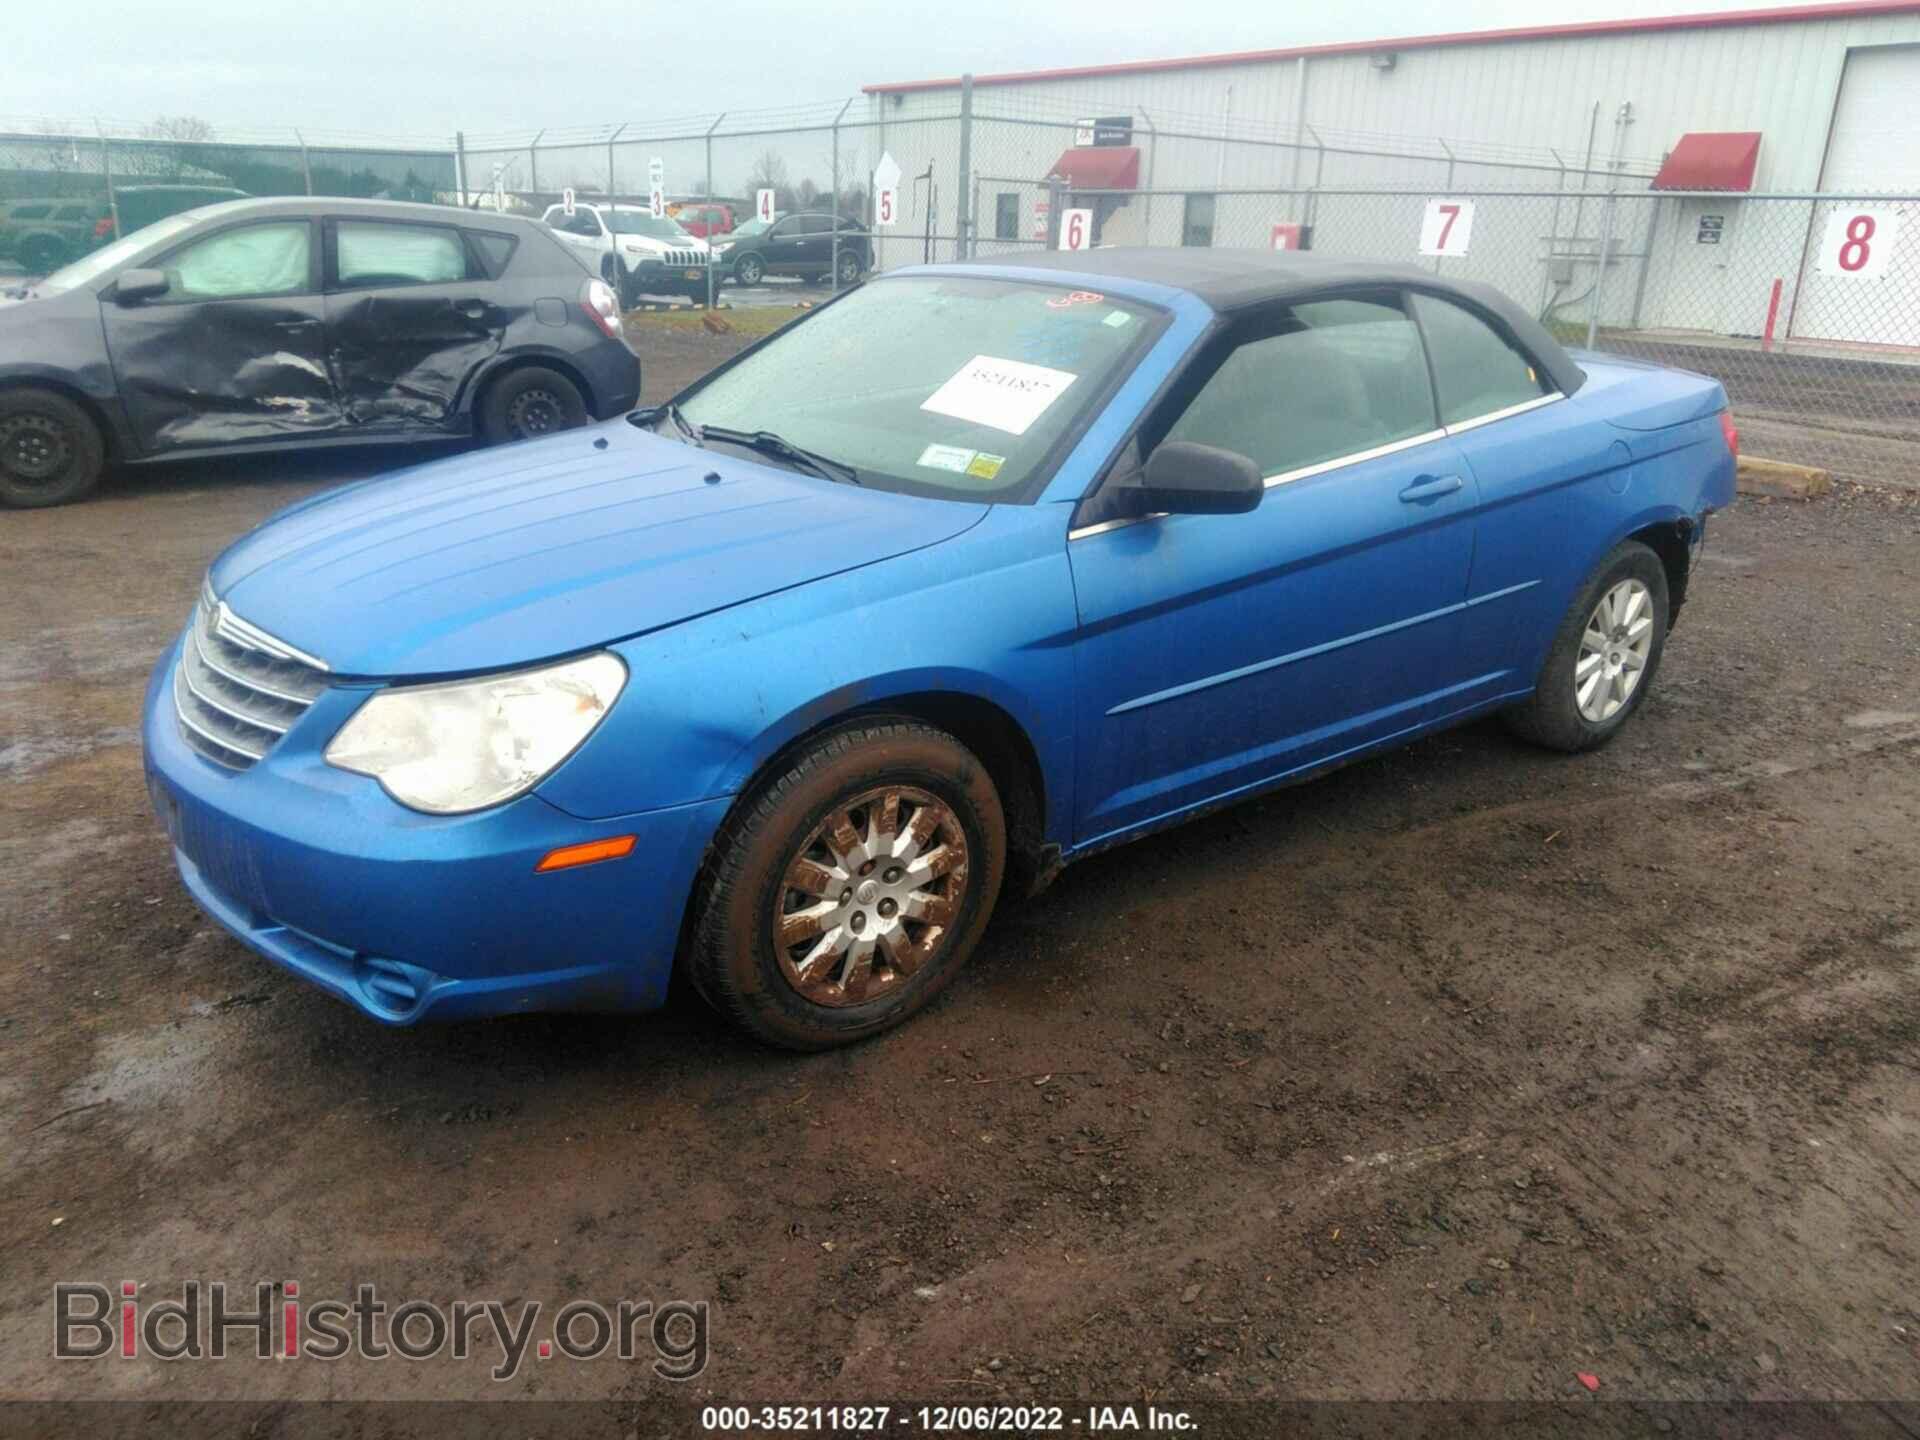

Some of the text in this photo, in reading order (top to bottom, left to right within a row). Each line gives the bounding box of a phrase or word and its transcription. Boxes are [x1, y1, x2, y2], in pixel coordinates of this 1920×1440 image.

[653, 192, 661, 216] 3
[761, 192, 770, 221] 4
[881, 191, 891, 221] 5
[1068, 213, 1082, 250] 6
[1437, 205, 1460, 249] 7
[1838, 214, 1876, 272] 8
